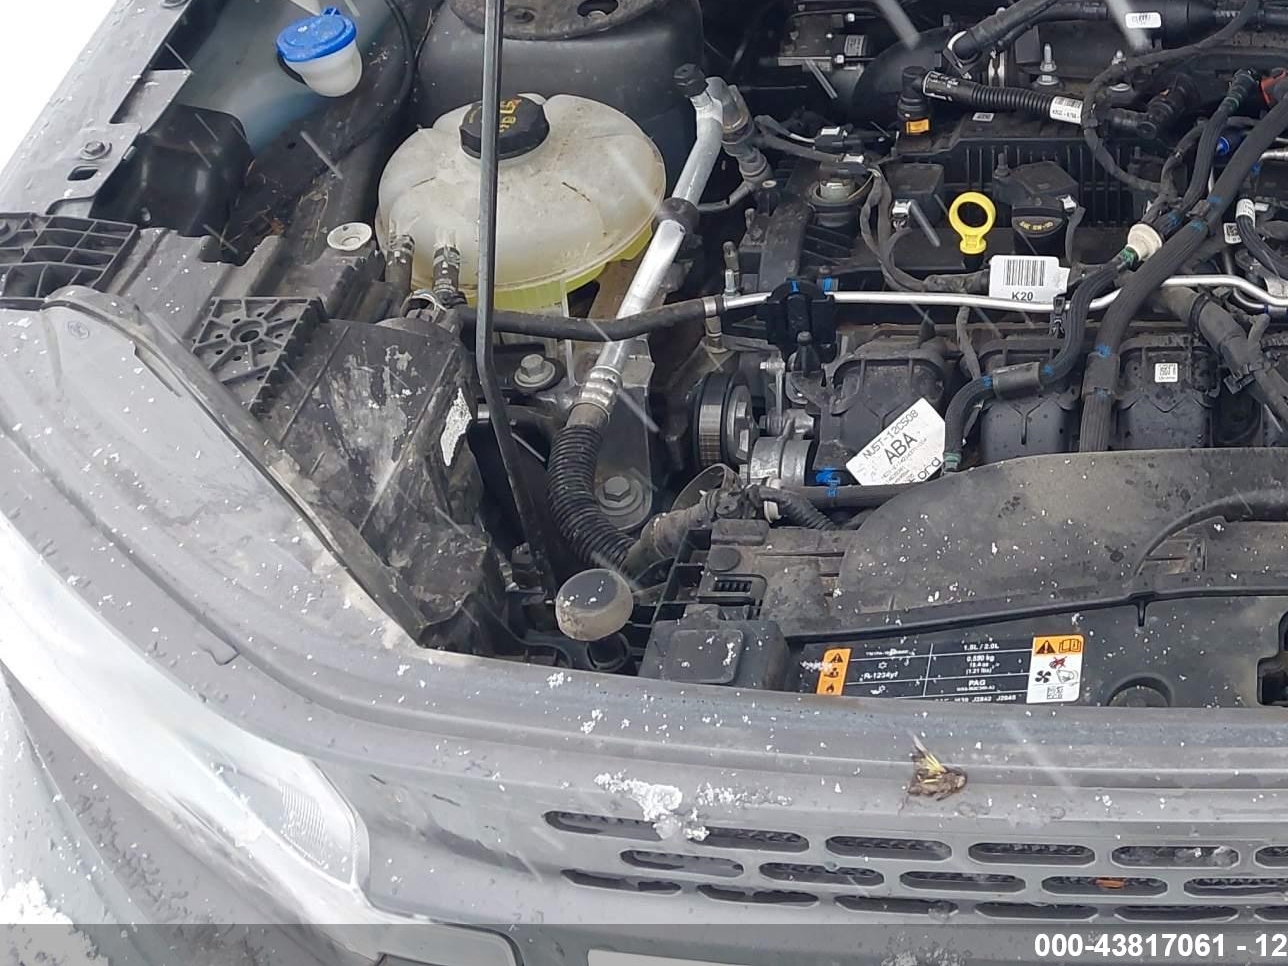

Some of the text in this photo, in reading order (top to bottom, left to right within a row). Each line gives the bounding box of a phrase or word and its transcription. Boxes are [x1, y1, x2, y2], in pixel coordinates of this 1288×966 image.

[1011, 291, 1034, 301] K20
[883, 432, 918, 465] ABA
[863, 671, 899, 680] R-1234yf
